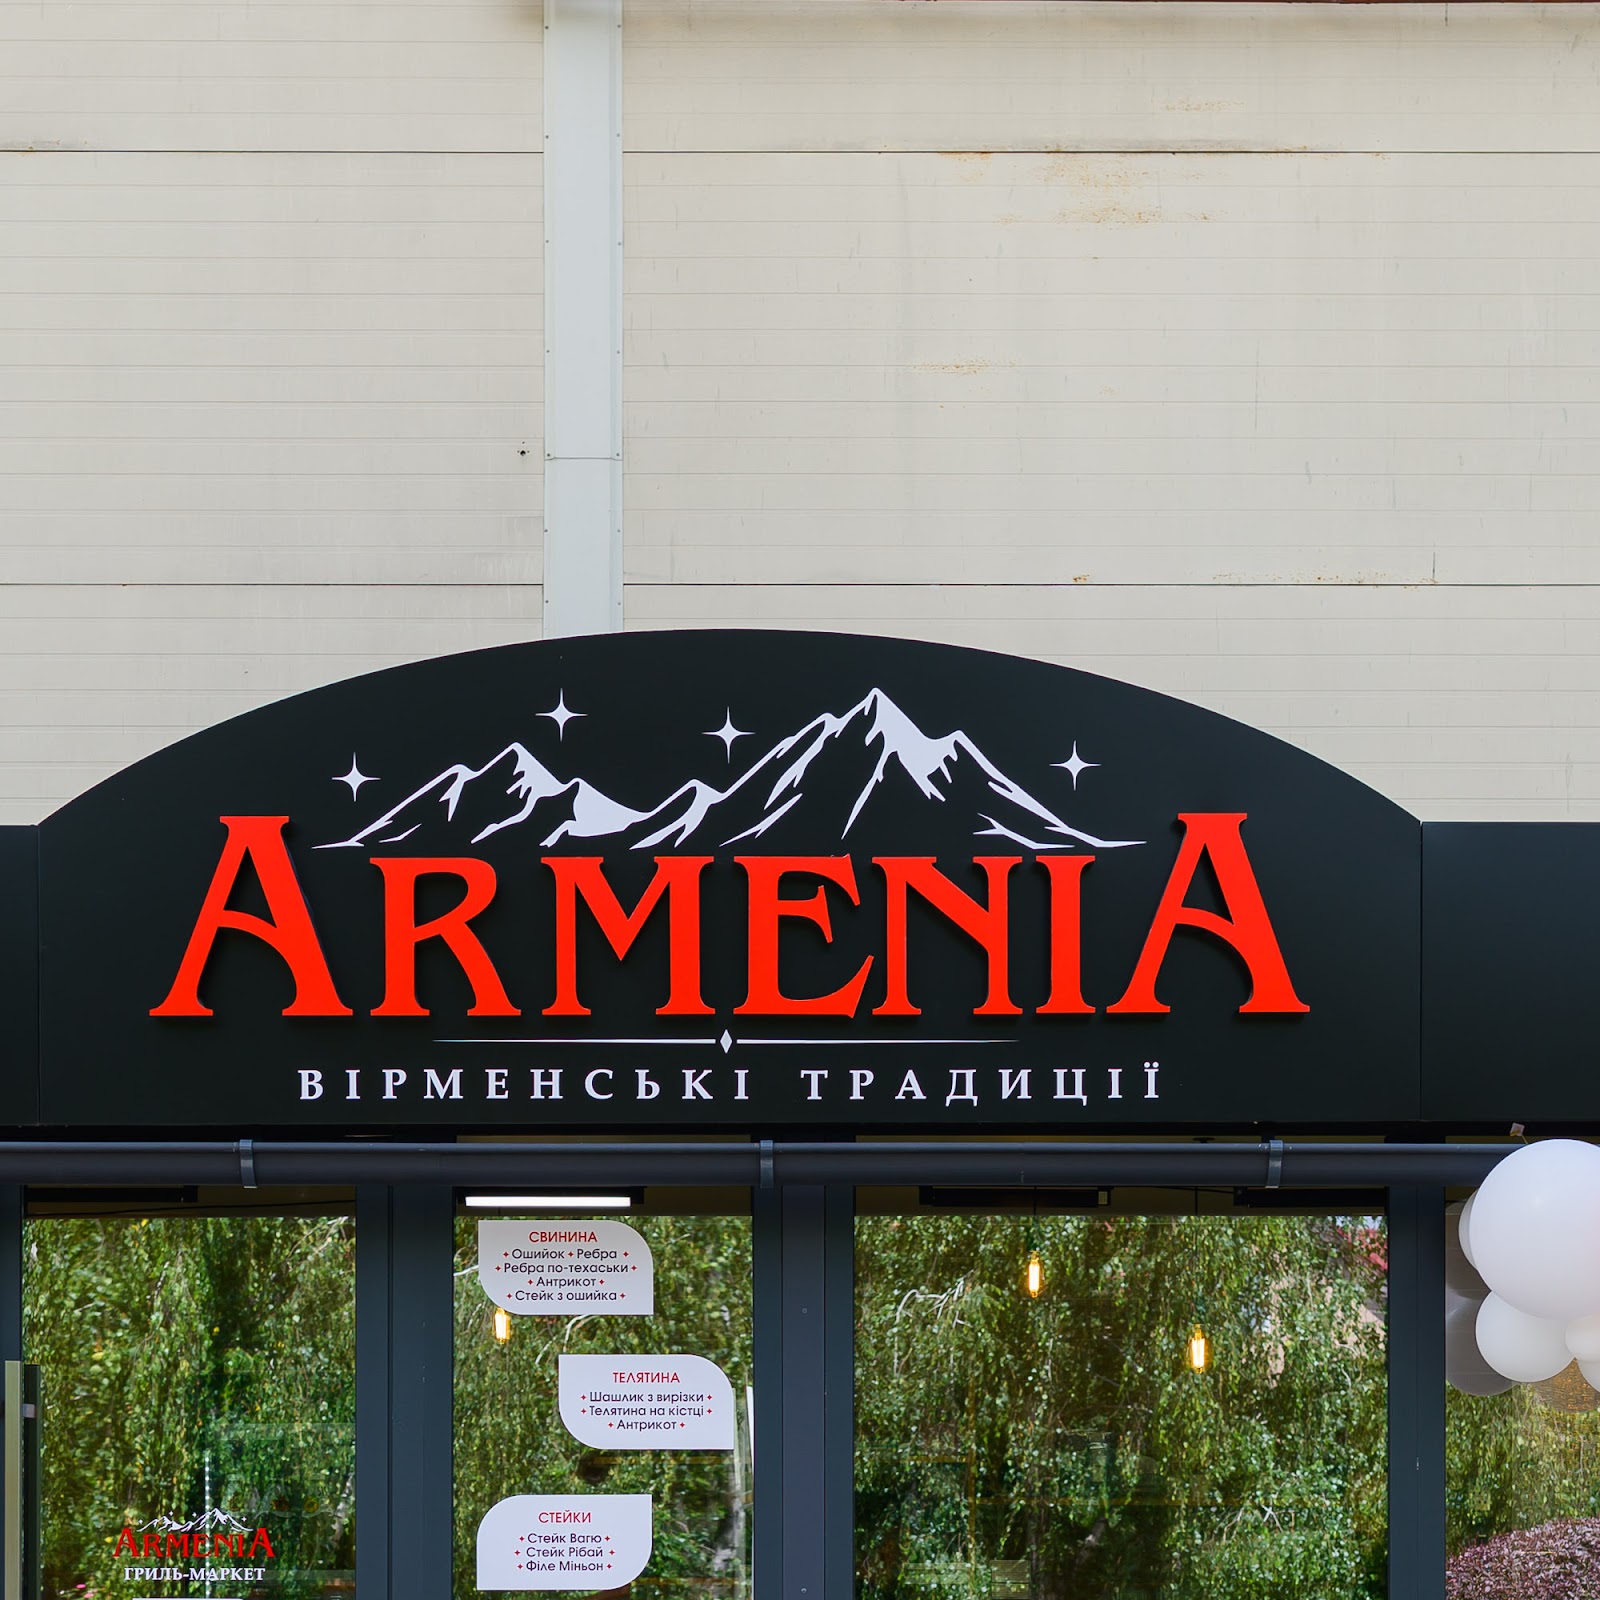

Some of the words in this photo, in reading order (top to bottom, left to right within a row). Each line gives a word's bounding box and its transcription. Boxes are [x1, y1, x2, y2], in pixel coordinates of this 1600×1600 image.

[150, 813, 1310, 1018] ARMENIA
[298, 1069, 748, 1099] ВІРМЕНСЬКІ
[801, 1062, 1158, 1106] ТРАДИЦІЇ
[530, 1232, 597, 1242] СВИНИНА
[512, 1249, 565, 1259] Ошийок
[577, 1249, 617, 1261] Ребра
[504, 1263, 544, 1275] Ребра
[548, 1265, 628, 1273] по-техаськи
[536, 1277, 596, 1288] Антрикот
[515, 1290, 554, 1300] Стейк
[566, 1290, 616, 1300] ошийка
[614, 1372, 680, 1383] ТЕЛЯТИНА
[590, 1392, 643, 1402] Шашлик
[648, 1394, 653, 1402] з
[657, 1392, 703, 1404] вирізки
[589, 1406, 646, 1415] Телятина
[669, 1406, 703, 1417] кістці
[617, 1420, 676, 1432] Антрикот
[539, 1510, 591, 1522] СТЕЙКИ
[114, 1528, 274, 1557] ARMENIA
[528, 1533, 566, 1543] Стейк
[571, 1533, 601, 1543] Вагю
[526, 1547, 564, 1557] Стейк
[569, 1547, 603, 1557] Рібай
[526, 1560, 555, 1571] Філе
[560, 1561, 603, 1571] Міньон
[125, 1568, 265, 1580] ГРИЛЬ-МАРКЕТ
